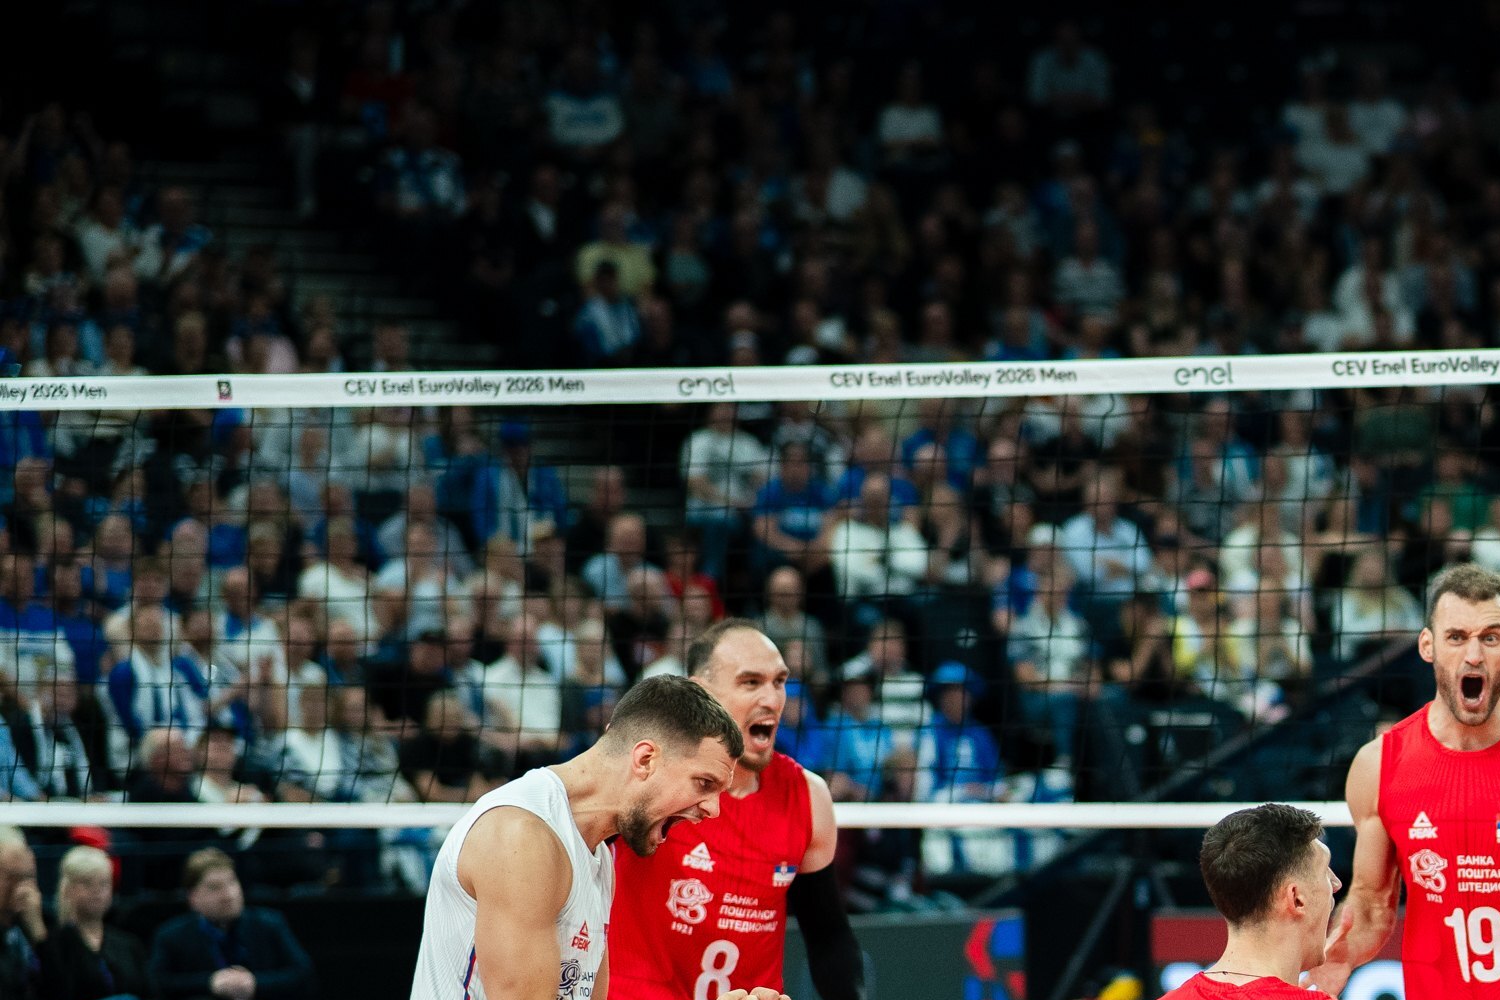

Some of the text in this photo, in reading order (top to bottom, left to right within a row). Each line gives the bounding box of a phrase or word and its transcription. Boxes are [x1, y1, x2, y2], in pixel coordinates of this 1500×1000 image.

[1174, 362, 1233, 387] enel
[1332, 360, 1367, 376] CEV
[1372, 358, 1406, 374] Enel
[1412, 356, 1500, 375] EuroVolley
[344, 376, 585, 397] CEV Enel EuroVolley 2026 Men
[678, 373, 736, 396] enel
[830, 368, 1077, 388] CEV Enel EuroVolley 2026 Men
[31, 383, 69, 399] 2026
[72, 383, 107, 399] Men
[1408, 826, 1438, 840] PEAK
[1456, 855, 1495, 866] БАНКА
[722, 892, 759, 906] БАНКА
